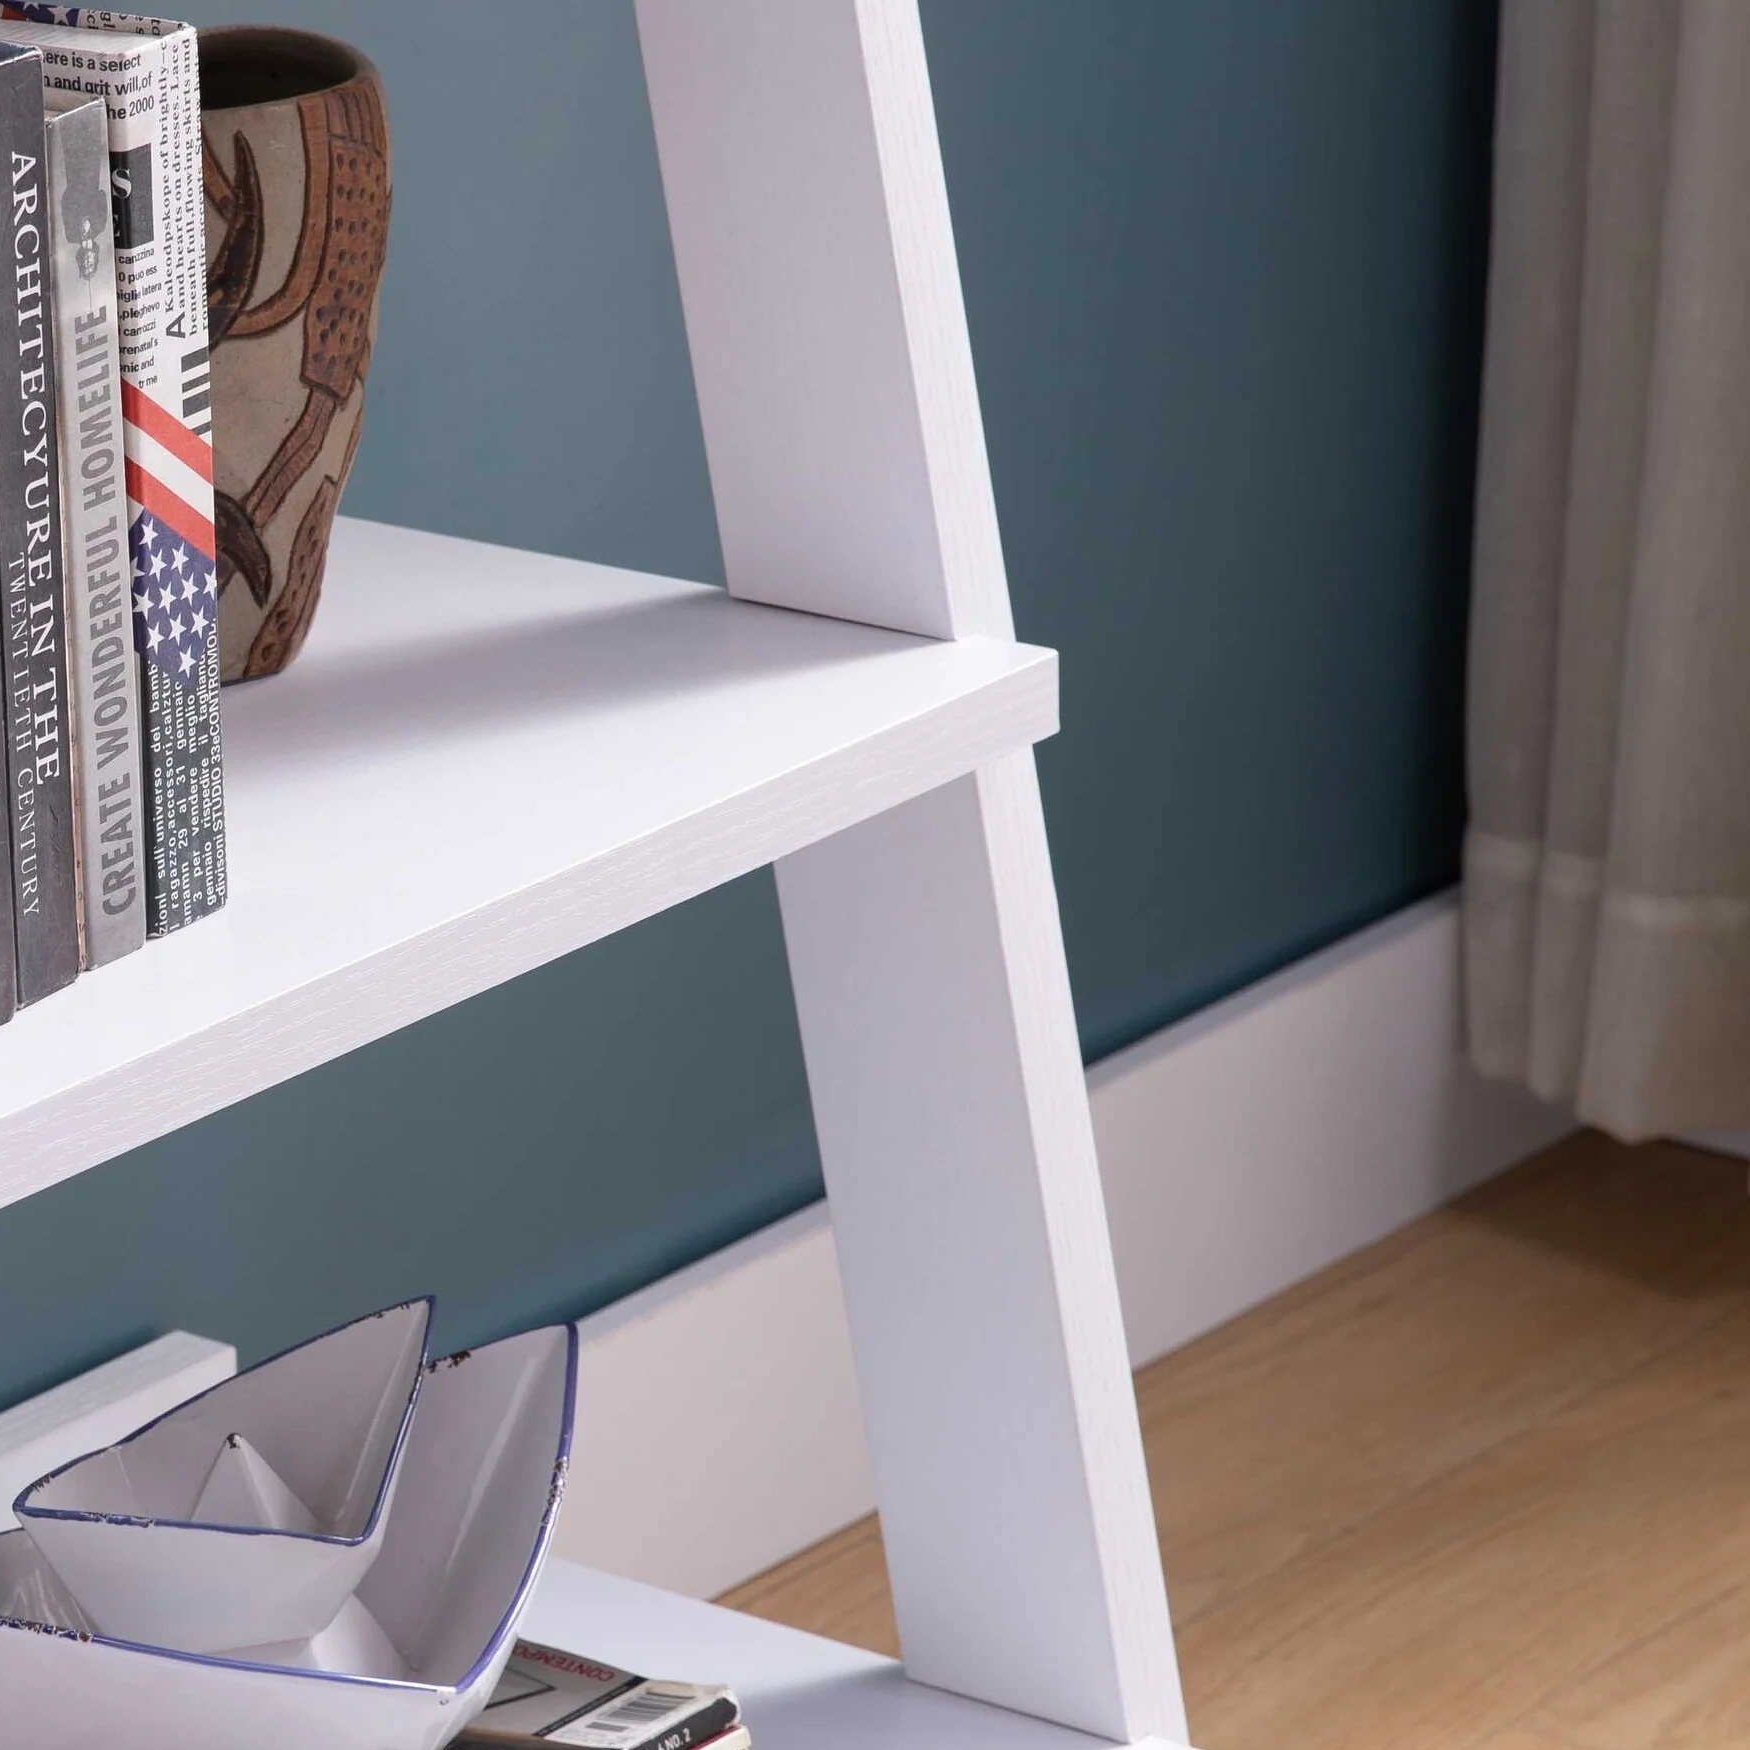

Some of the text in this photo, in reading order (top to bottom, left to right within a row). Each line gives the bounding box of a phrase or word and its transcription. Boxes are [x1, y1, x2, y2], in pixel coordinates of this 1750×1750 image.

[43, 53, 68, 66] ere
[72, 52, 83, 68] is
[88, 58, 95, 70] a
[170, 43, 180, 90] Lace
[182, 38, 191, 74] and
[54, 76, 81, 92] and
[129, 96, 154, 118] 2000
[182, 78, 192, 135] skirts
[160, 150, 169, 169] of
[174, 179, 182, 202] on
[175, 206, 185, 268] hearts
[175, 273, 186, 309] and
[188, 258, 198, 337] beneath
[166, 311, 186, 338] A
[141, 354, 155, 370] and
[11, 151, 60, 785] ARCHITECYURE IN THE
[74, 305, 137, 915] CREATE WONDERFUL HOMELIFE
[148, 660, 160, 714] bamb
[8, 552, 40, 916] TWENTIETH CENTURY
[150, 726, 161, 753] del
[176, 765, 186, 786] 31
[200, 757, 214, 829] rispedire
[176, 798, 188, 814] al
[185, 694, 204, 903] 3 per vendere meglio
[210, 768, 224, 832] STUDIO
[178, 828, 189, 849] 29
[202, 841, 217, 906] gennaio
[682, 1727, 692, 1743] 2
